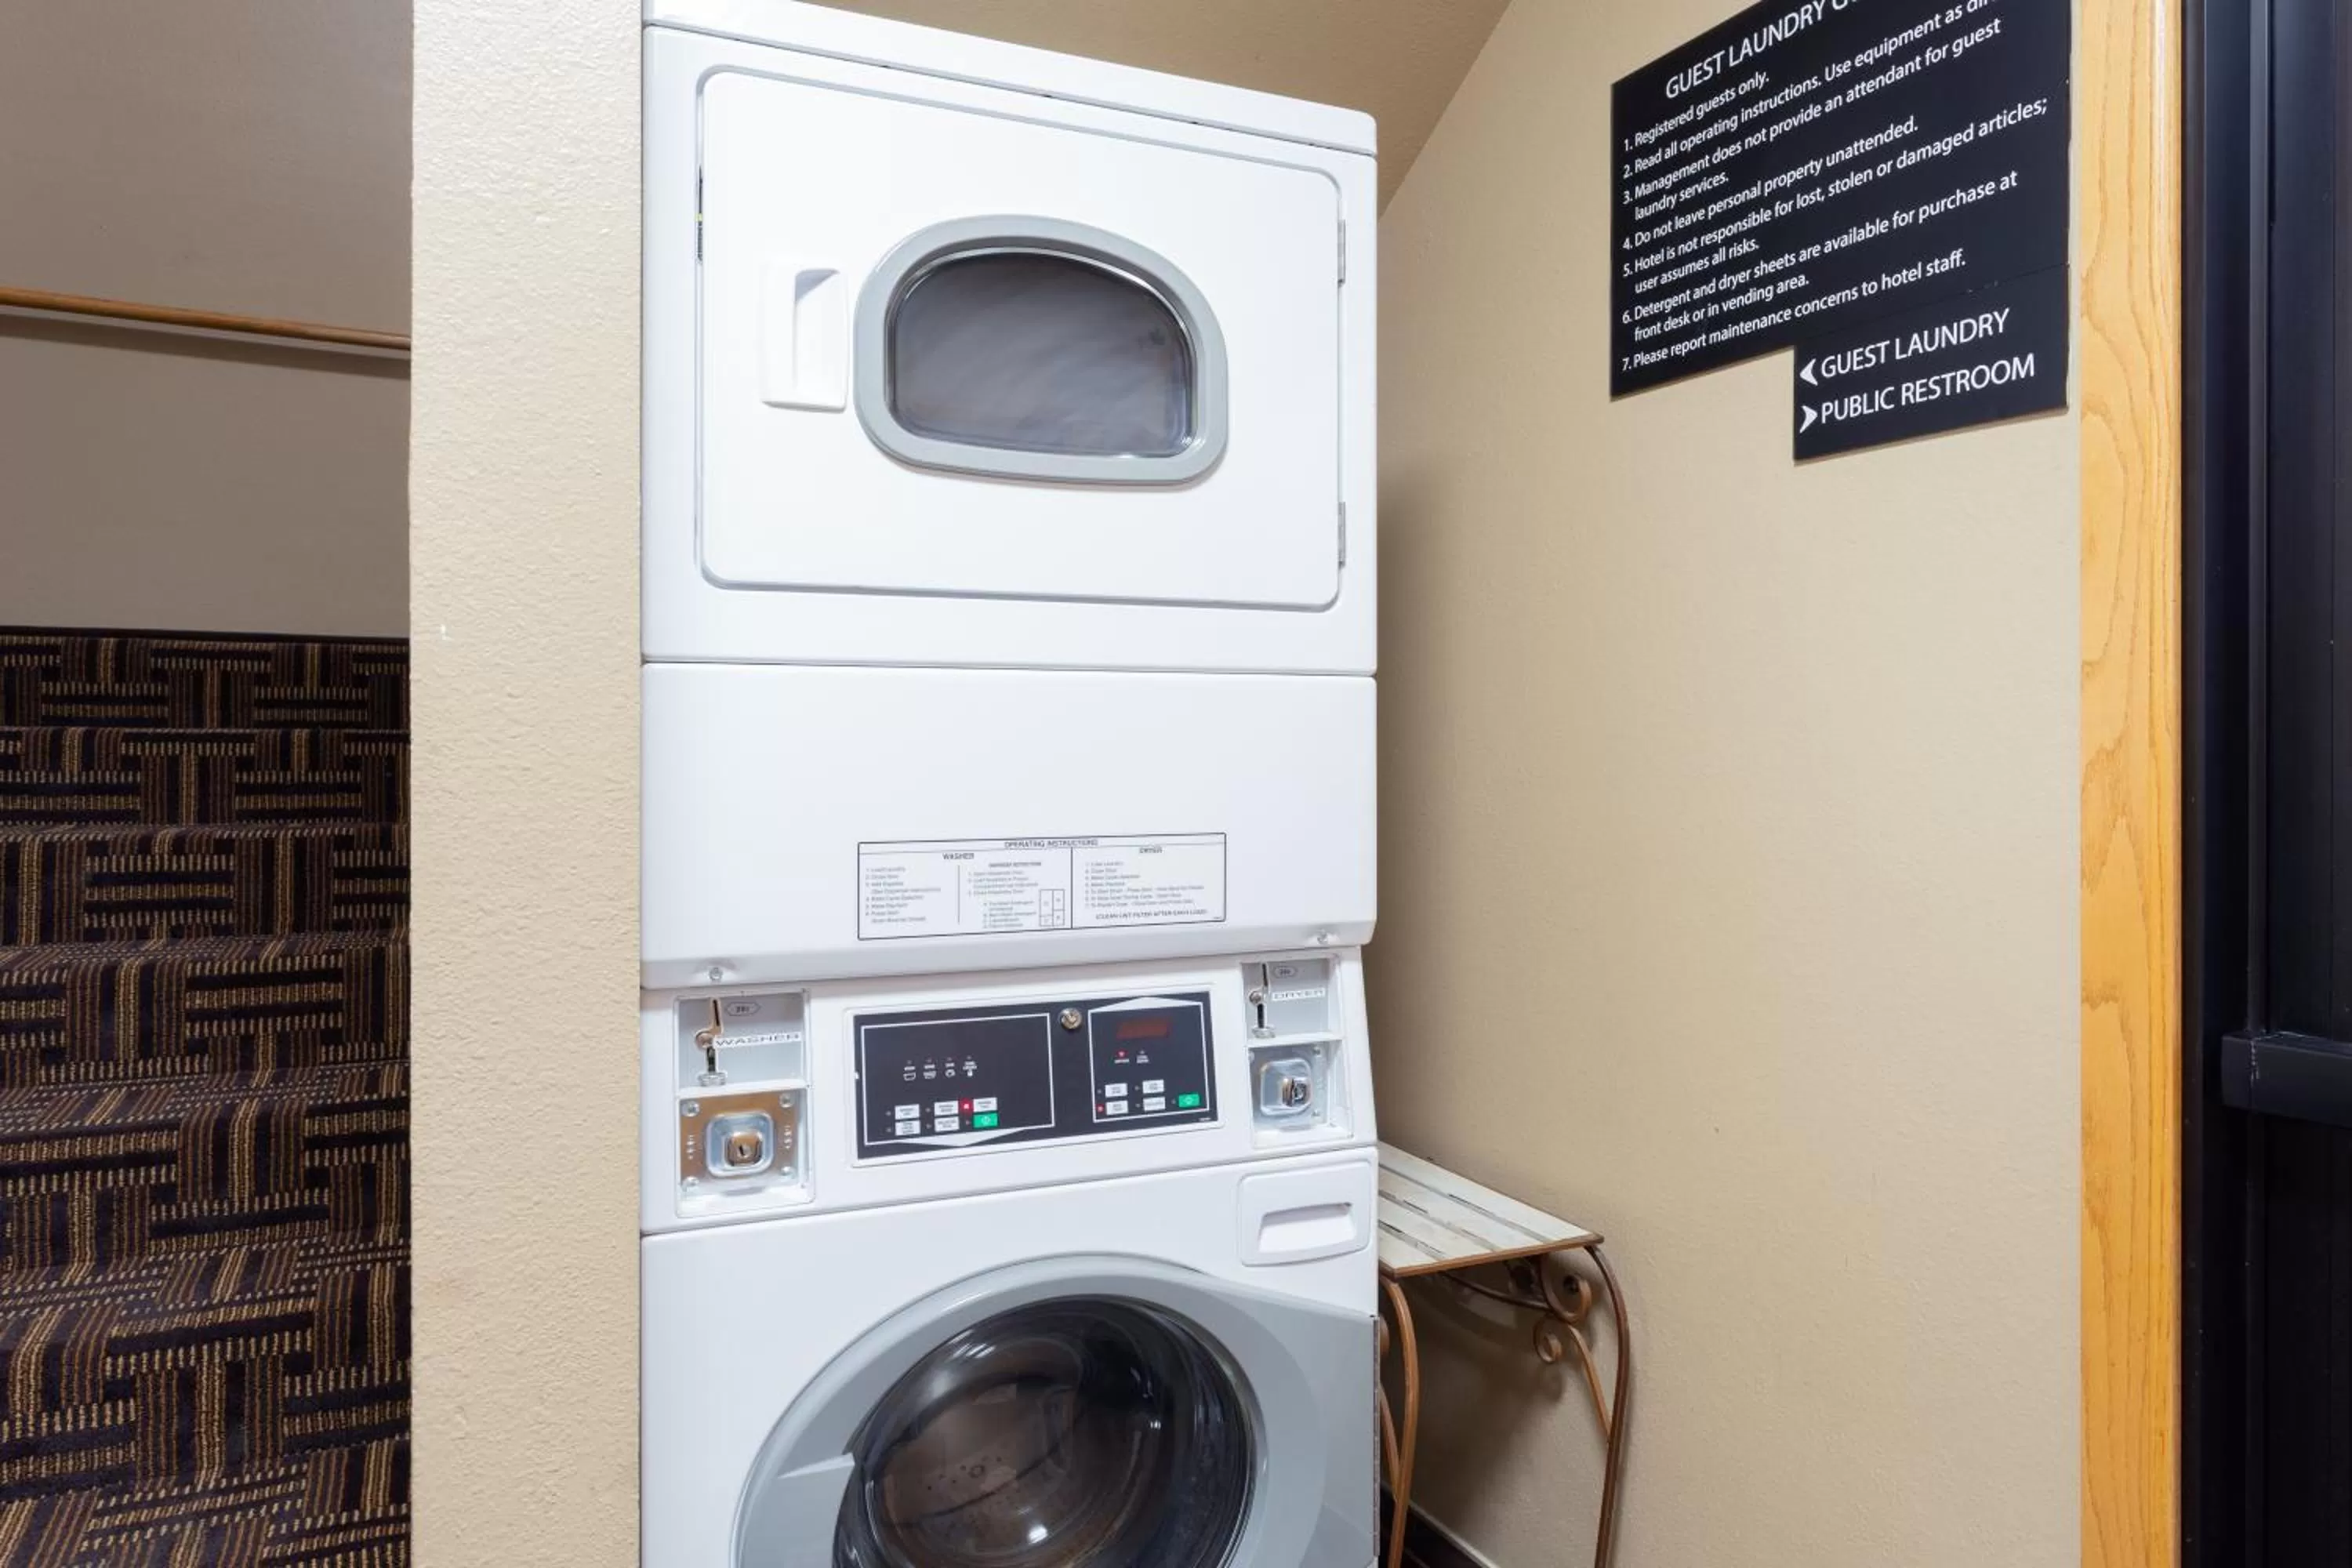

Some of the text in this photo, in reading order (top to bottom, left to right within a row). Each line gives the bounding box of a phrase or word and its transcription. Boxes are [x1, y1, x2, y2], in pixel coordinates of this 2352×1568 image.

[1624, 164, 1632, 179] 2.
[1635, 148, 1662, 173] Read
[1664, 140, 1677, 159] all
[1679, 115, 1738, 151] operating
[1741, 76, 1821, 123] instructions.
[1825, 60, 1852, 82] Use
[1854, 13, 1941, 67] equipment
[1944, 5, 1962, 24] as
[1667, 0, 1825, 98] GUEST LAUNDRY
[1623, 18, 2001, 204] 3. Management does not provide an attendant for guest
[1624, 72, 1769, 151] 1. Registered guests only.
[1623, 115, 1918, 249] 4. Do not leave personal property unattended.
[1623, 98, 2047, 277] 5. Hotel is not responsible for lost, stolen or damaged articles;
[1635, 172, 1729, 220] laundry services.
[1622, 170, 2017, 324] 6. Detergent and dryer sheets are available for purchase at
[1635, 238, 1759, 293] user assumes all risks.
[1622, 248, 1965, 371] 7. Please report maintenance concerns to hotel staff.
[1635, 274, 1809, 341] front desk or in vending area.
[1821, 307, 2009, 378] GUEST LAUNDRY
[1821, 353, 2034, 423] PUBLIC RESTROOM
[716, 1034, 800, 1046] WASHER
